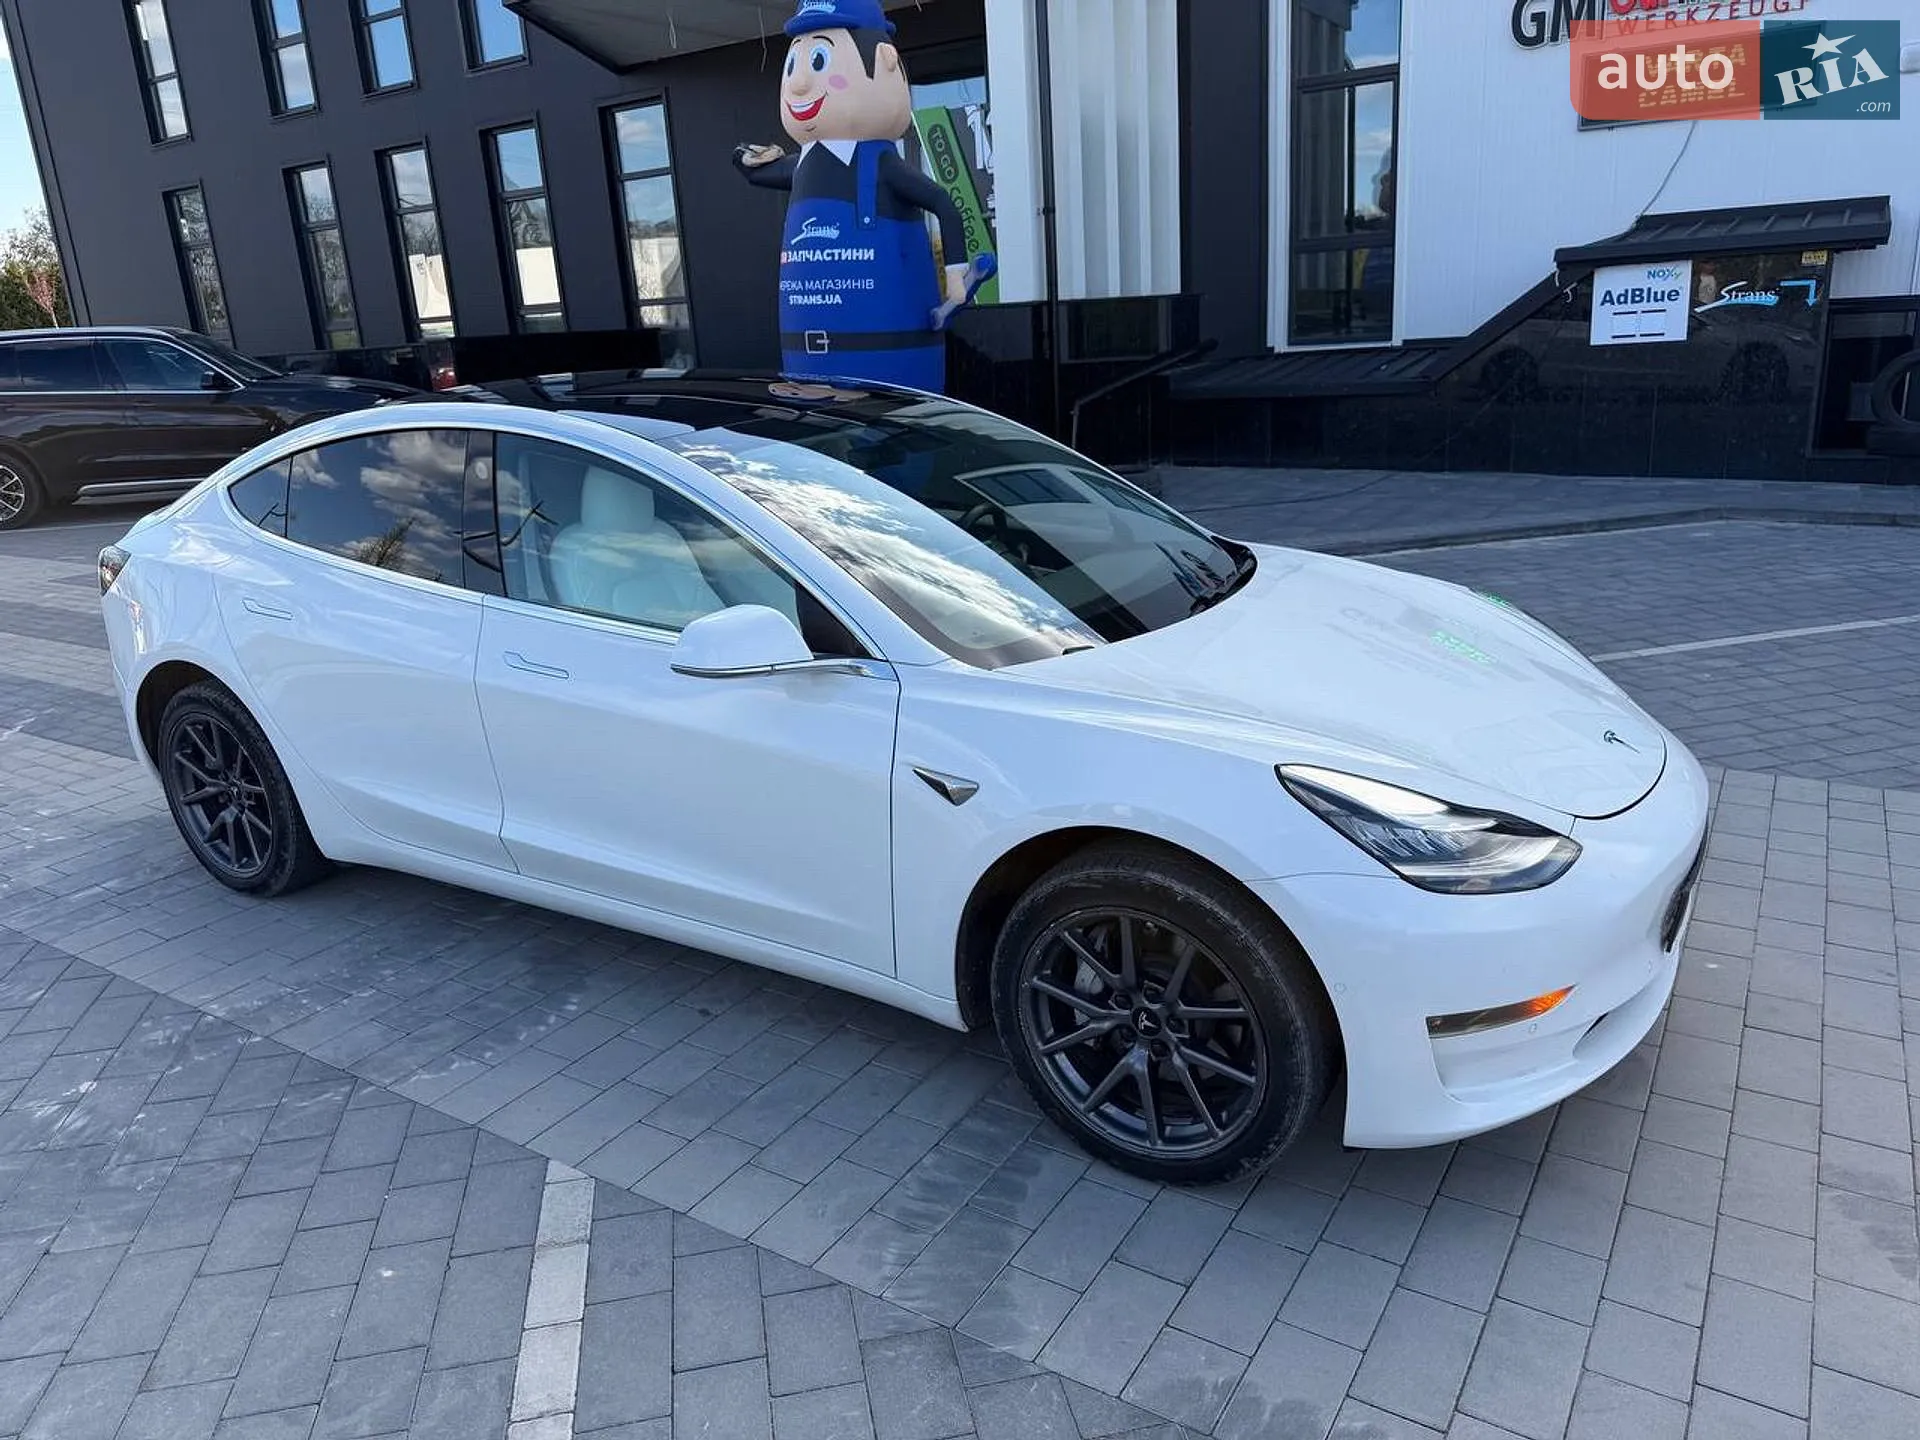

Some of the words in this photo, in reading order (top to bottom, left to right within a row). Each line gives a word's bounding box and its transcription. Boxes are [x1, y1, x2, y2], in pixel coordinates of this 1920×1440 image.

[805, 279, 875, 290] МАГАЗИНІВ
[1600, 287, 1680, 306] AdBlue
[1694, 281, 1780, 313] Strans
